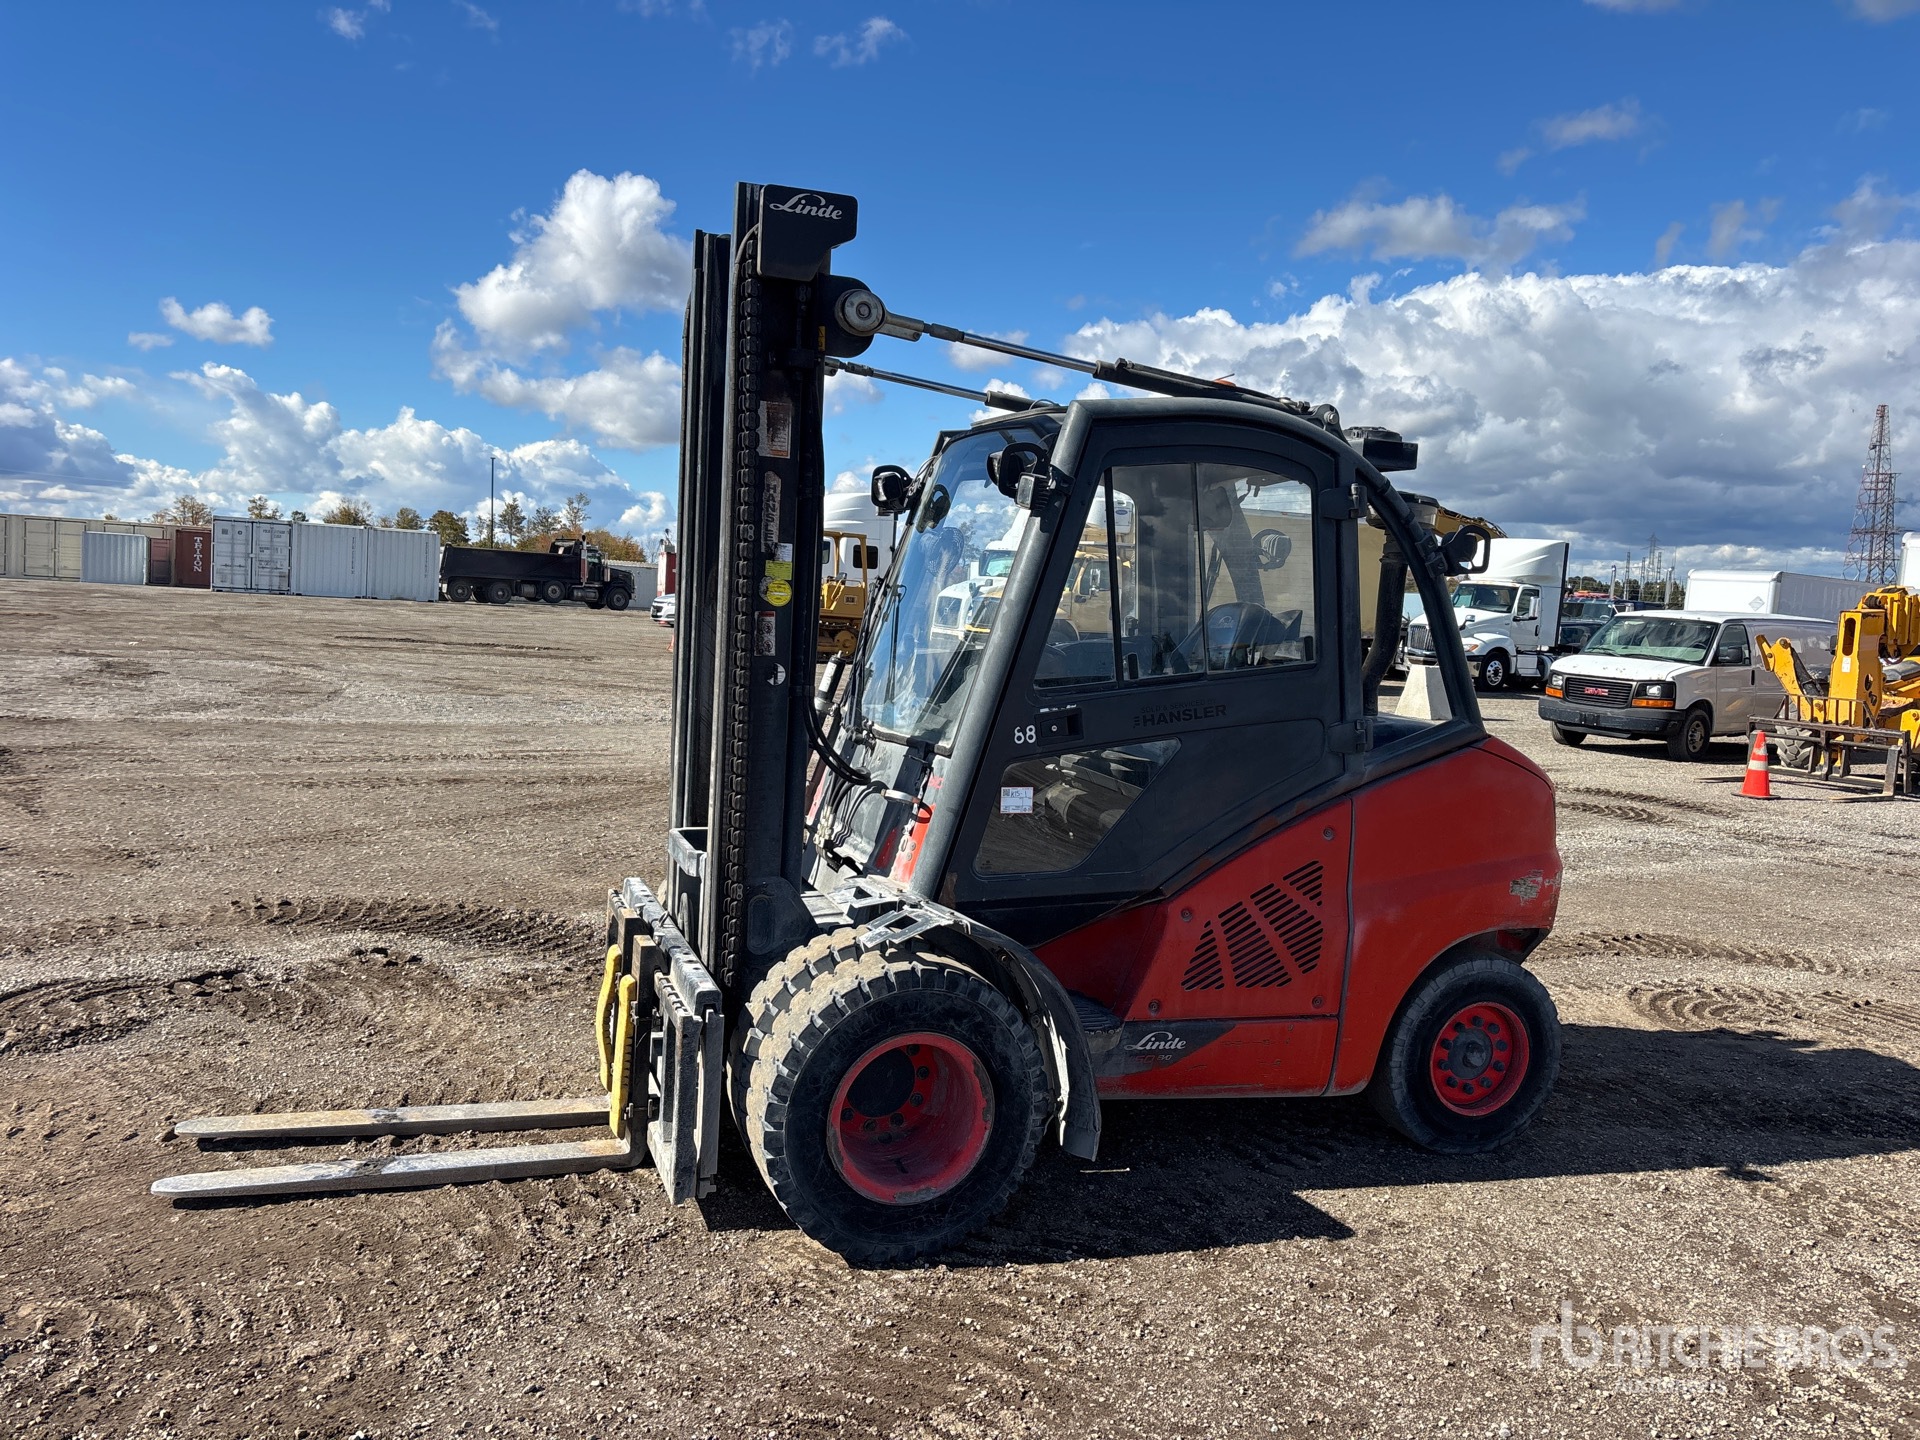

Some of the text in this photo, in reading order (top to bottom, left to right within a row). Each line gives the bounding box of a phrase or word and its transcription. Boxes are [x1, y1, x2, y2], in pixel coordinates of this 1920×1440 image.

[769, 193, 843, 220] Linde
[193, 536, 203, 572] TRITON
[1142, 704, 1227, 727] HANSLER
[1014, 724, 1036, 744] 68
[1124, 1031, 1187, 1051] Linde
